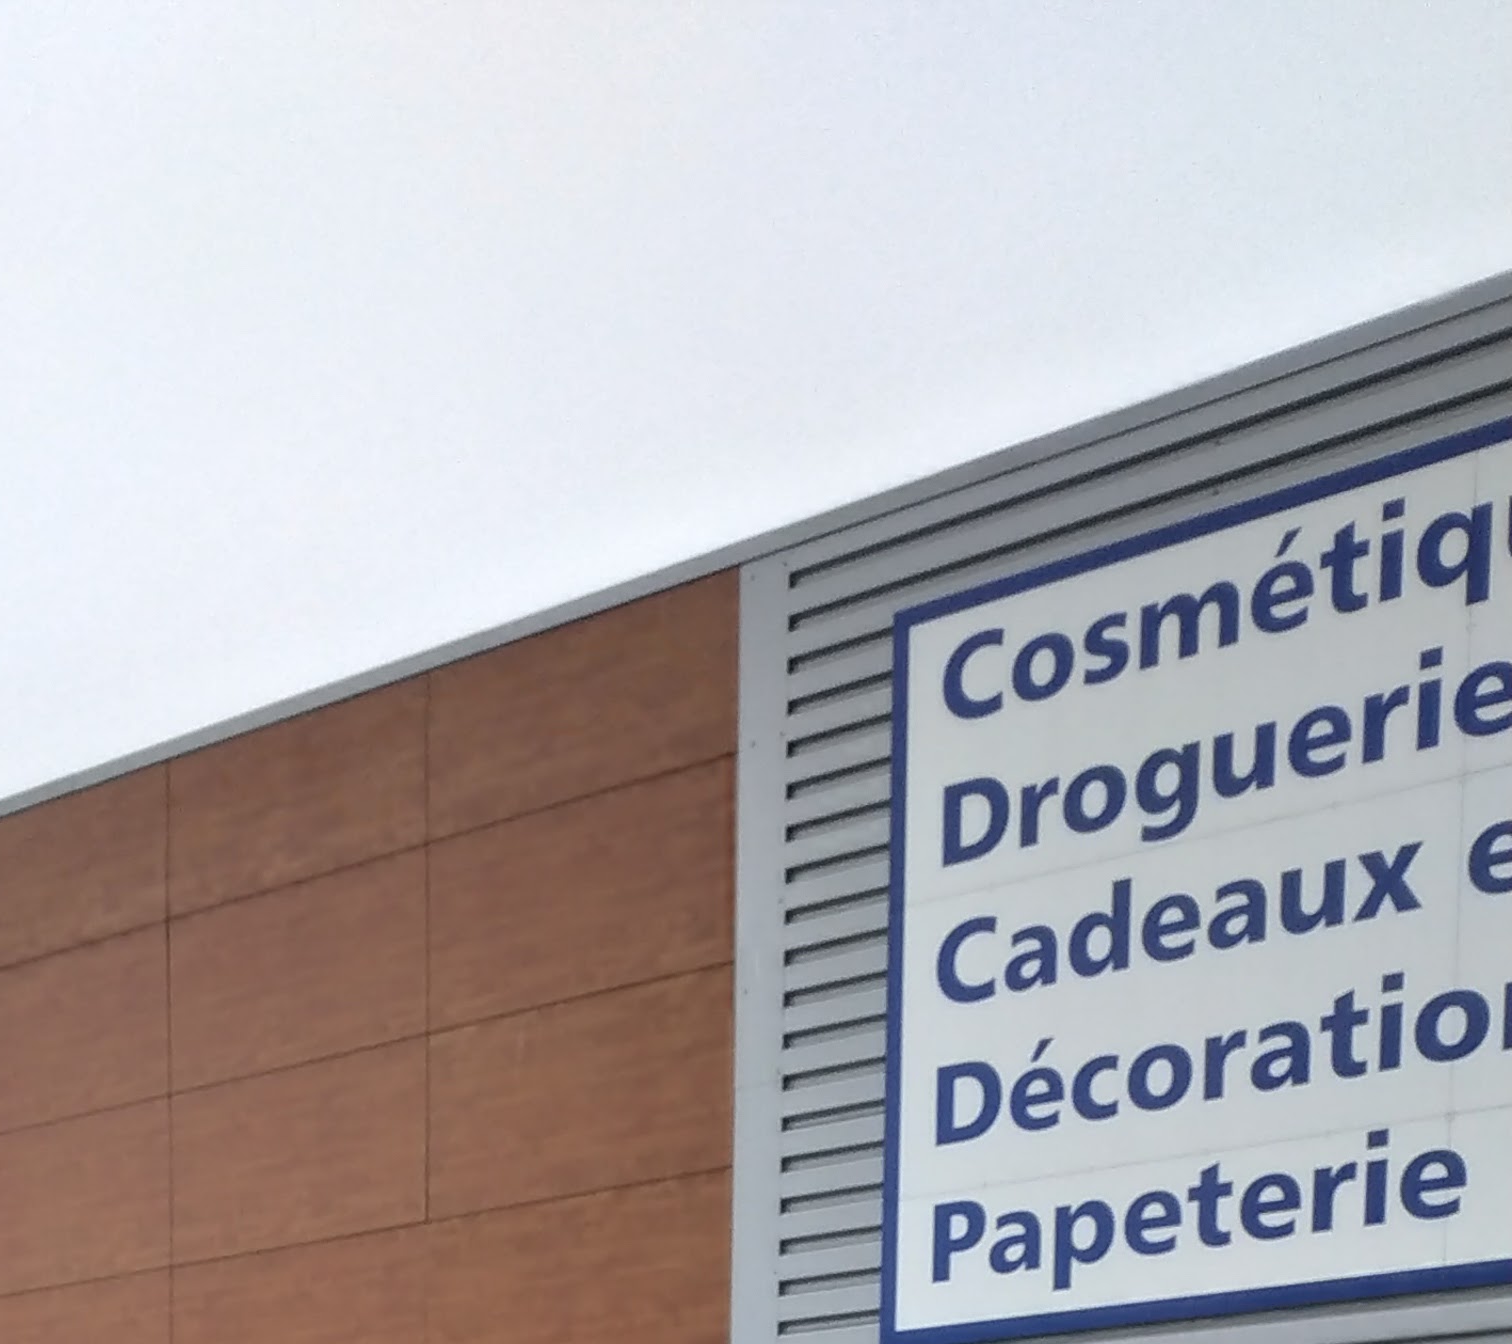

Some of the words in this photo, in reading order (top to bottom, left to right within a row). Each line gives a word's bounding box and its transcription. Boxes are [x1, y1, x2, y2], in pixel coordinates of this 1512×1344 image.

[942, 496, 1512, 720] Cosmétiq
[940, 646, 1512, 867] Droguerie
[935, 840, 1423, 1004] Cadeaux
[934, 972, 1512, 1147] Décoratio
[930, 1128, 1468, 1291] Papeterie
